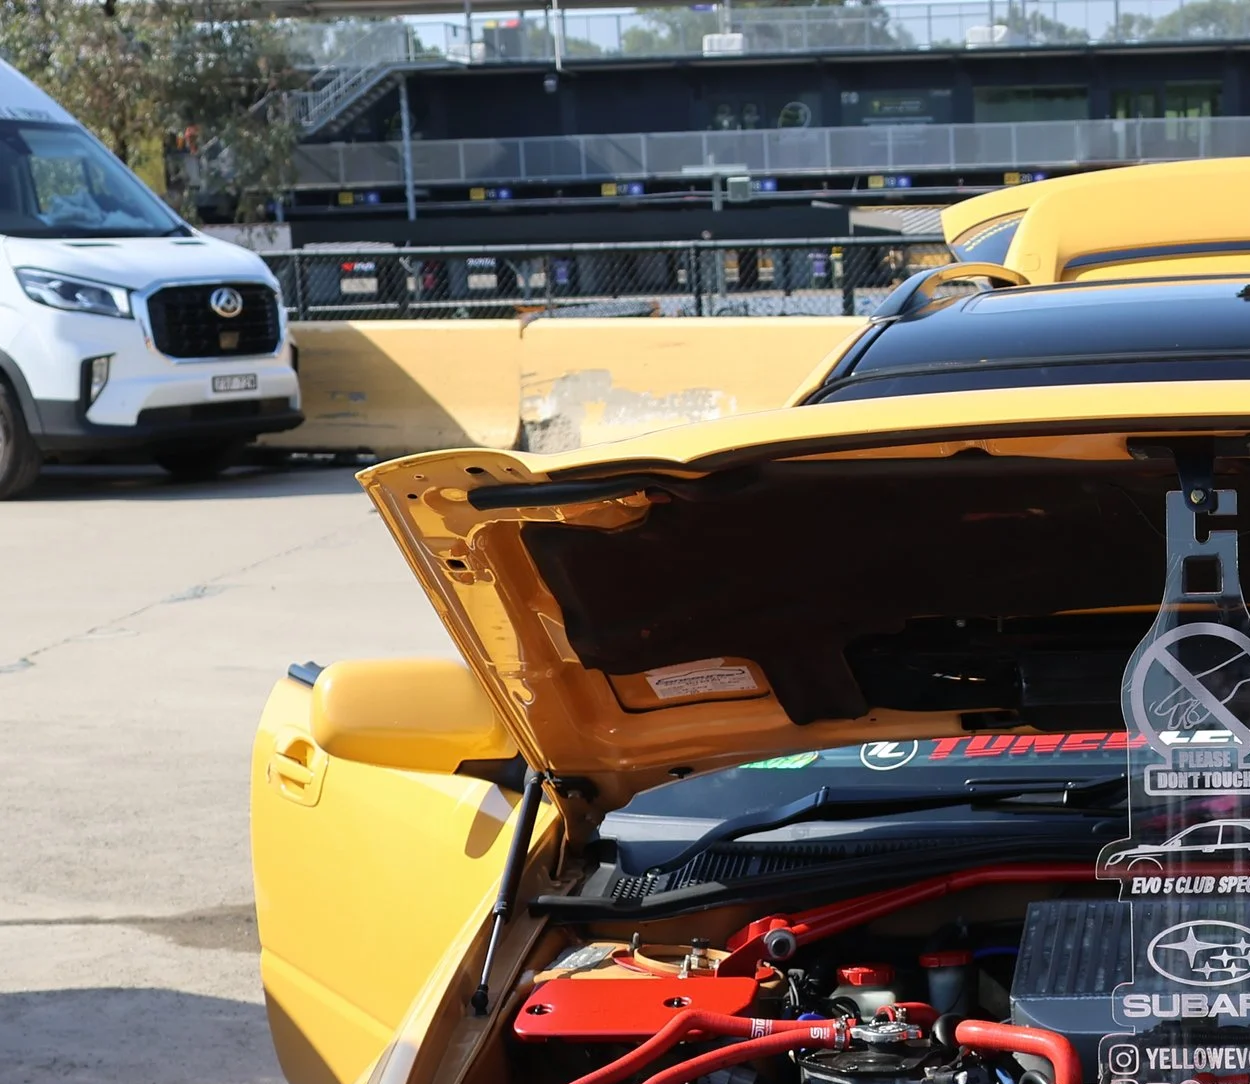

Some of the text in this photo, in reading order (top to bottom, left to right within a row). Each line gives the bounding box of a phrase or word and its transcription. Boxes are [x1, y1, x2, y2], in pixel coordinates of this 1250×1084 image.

[1179, 751, 1231, 768] PLEASE
[1157, 771, 1200, 788] DON'T
[1131, 876, 1162, 894] EVO
[1163, 877, 1174, 893] 5
[1175, 876, 1213, 894] CLUB
